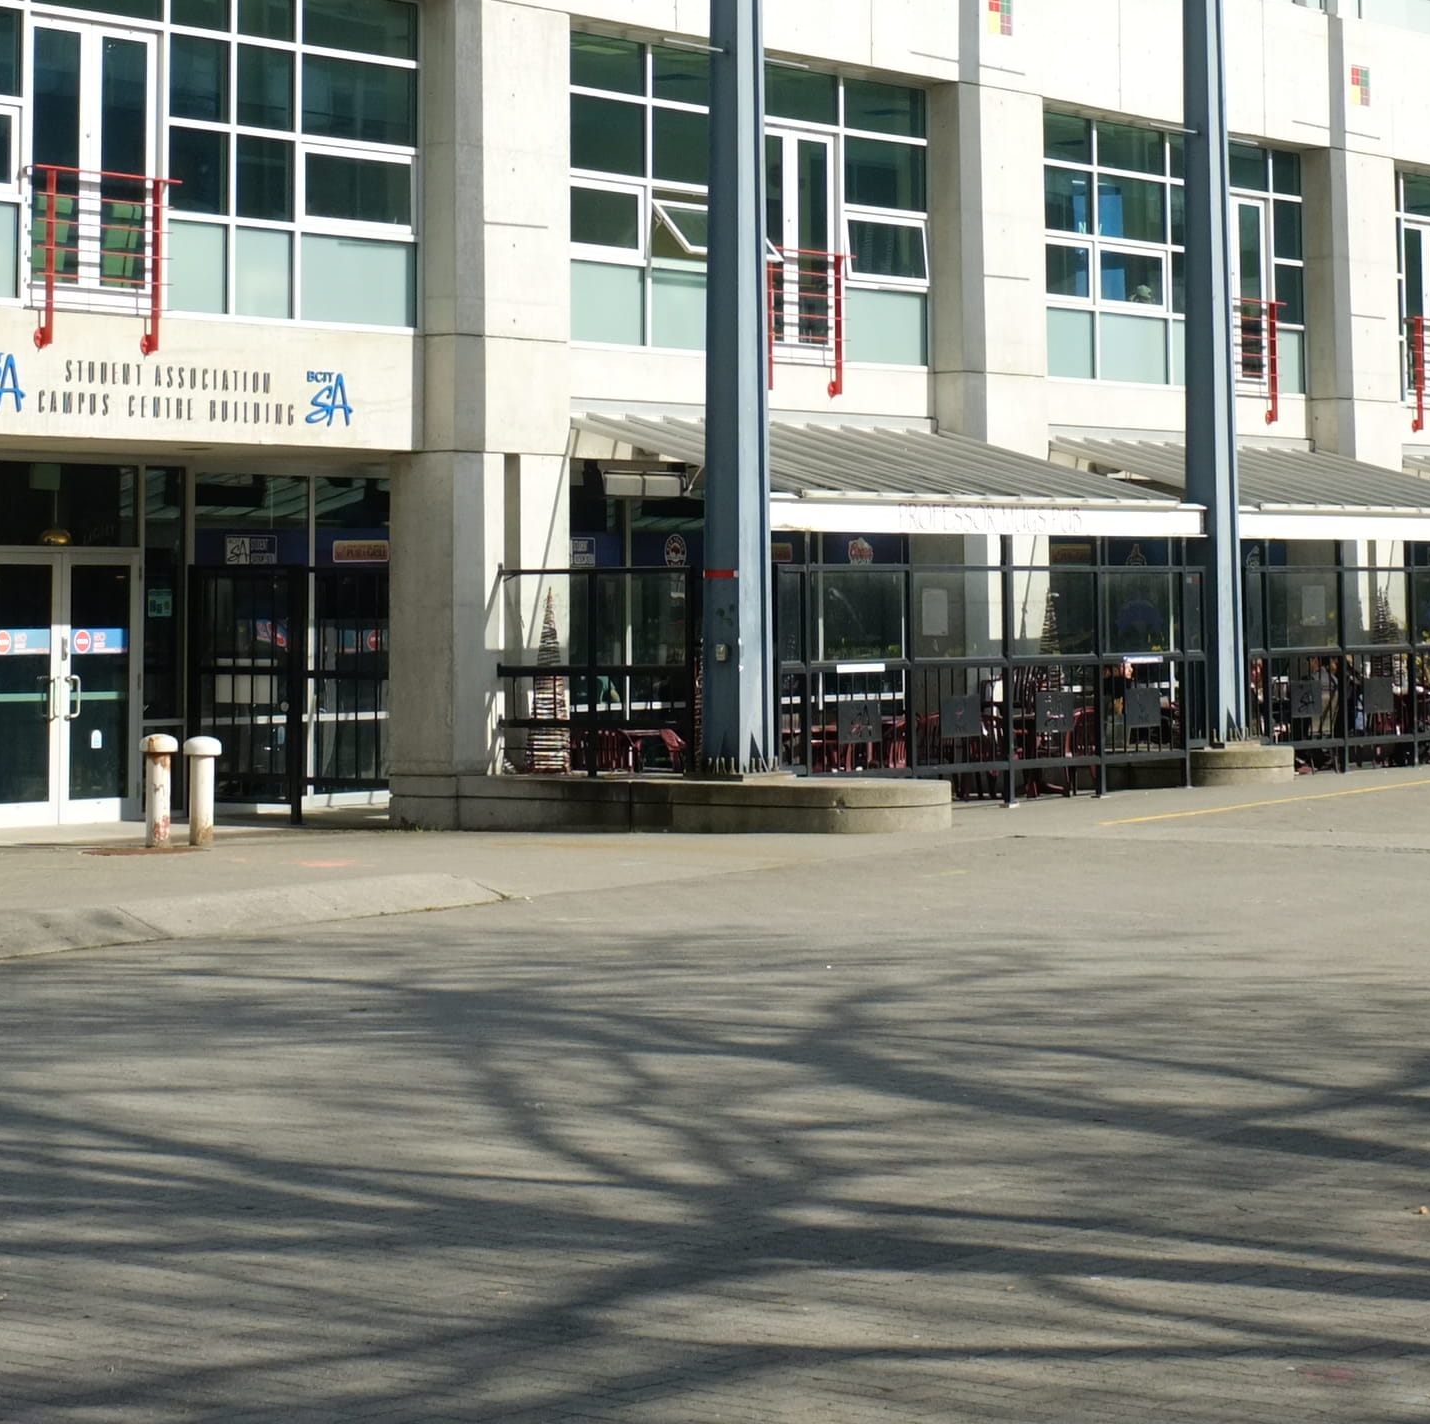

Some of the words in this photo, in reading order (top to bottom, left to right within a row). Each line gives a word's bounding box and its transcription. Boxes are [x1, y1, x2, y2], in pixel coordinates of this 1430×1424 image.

[65, 360, 141, 387] STUDENT
[154, 364, 270, 394] ASSOCIATION
[306, 370, 334, 383] BCIT
[38, 390, 110, 416] CAMPUS
[128, 395, 193, 421] CENTRE
[209, 399, 295, 426] BUILDING
[305, 373, 353, 427] SA
